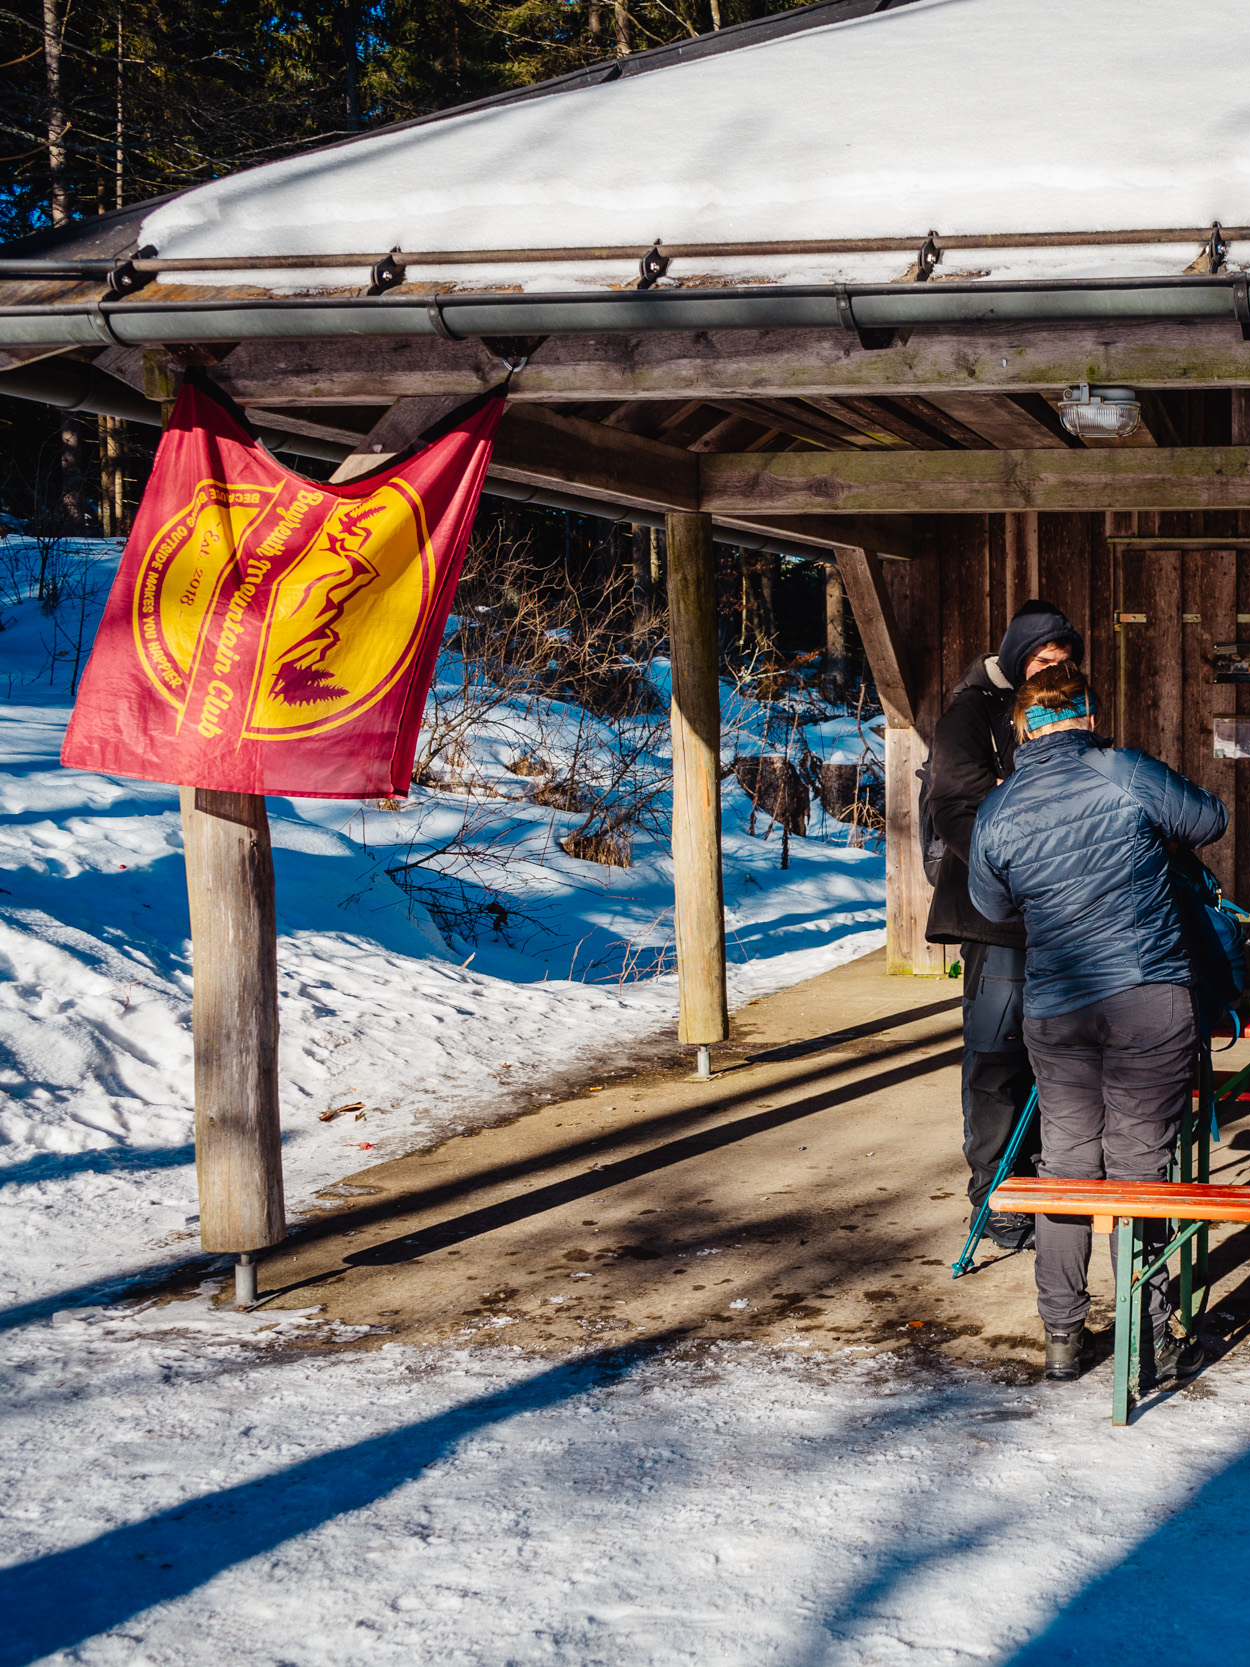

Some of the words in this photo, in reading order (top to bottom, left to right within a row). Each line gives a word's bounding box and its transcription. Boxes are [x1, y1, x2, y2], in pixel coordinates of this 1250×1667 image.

[209, 488, 260, 503] BECAUSE
[256, 490, 324, 557] Bayreuth
[152, 525, 188, 571] OUTSIDE
[142, 571, 159, 613] MAKES
[180, 568, 203, 606] 2018
[142, 616, 157, 639] YOU
[213, 558, 272, 677] Mountain
[148, 641, 183, 689] HAPPIER
[197, 680, 234, 739] Club
